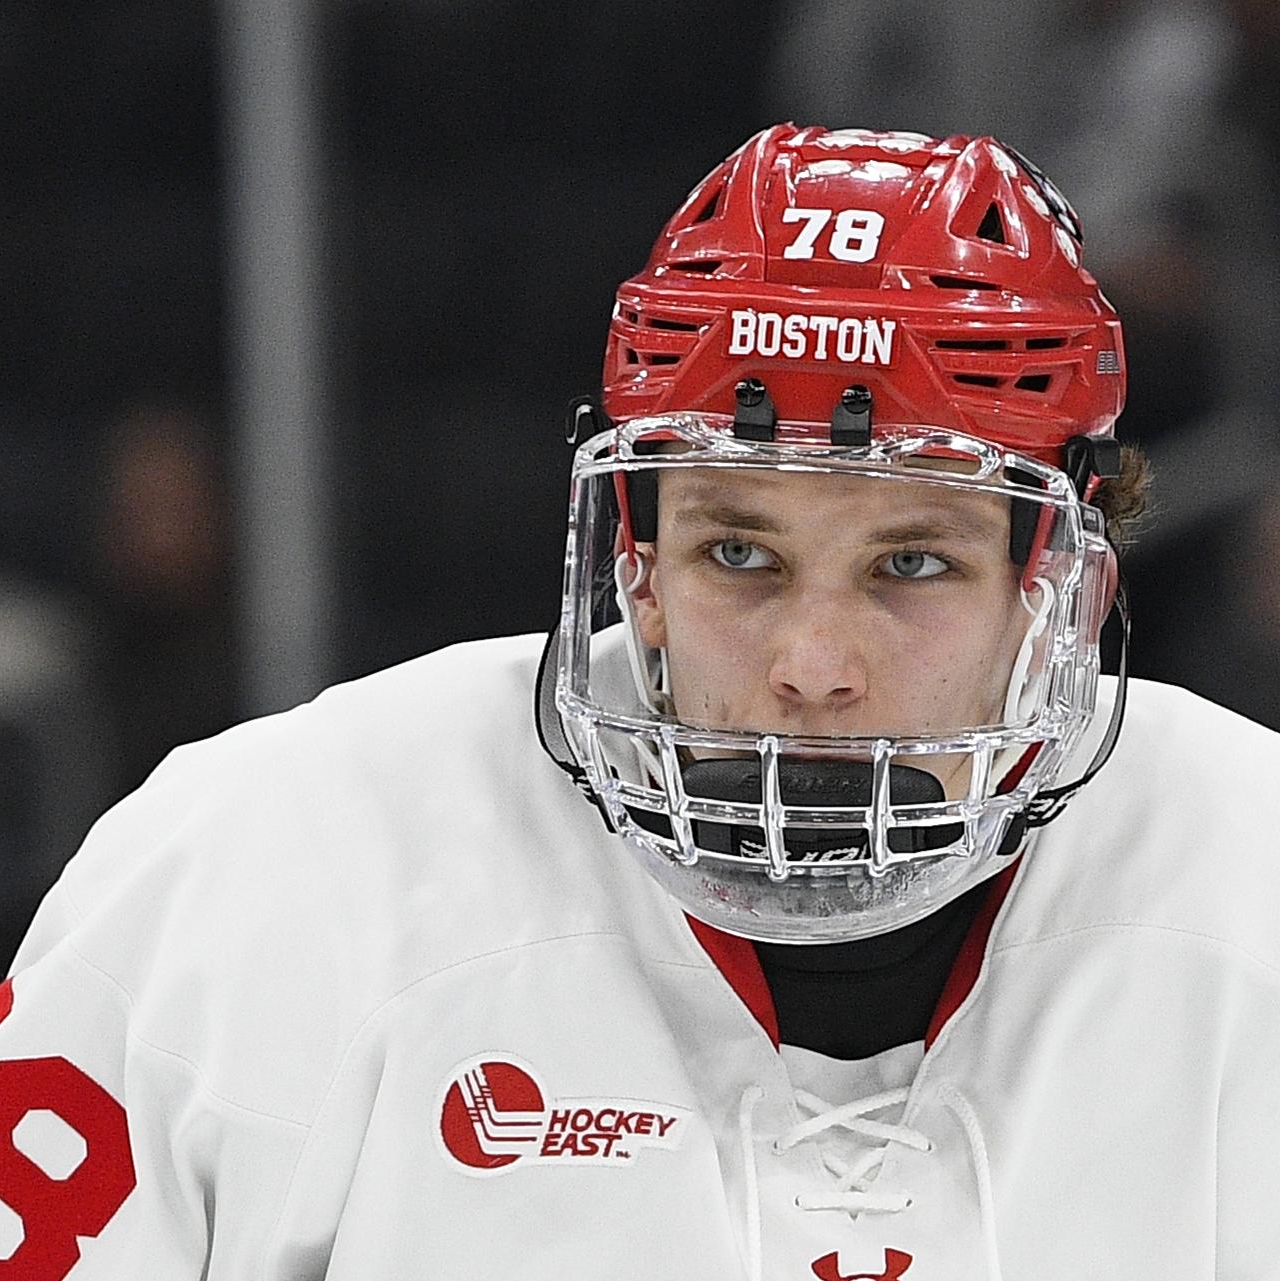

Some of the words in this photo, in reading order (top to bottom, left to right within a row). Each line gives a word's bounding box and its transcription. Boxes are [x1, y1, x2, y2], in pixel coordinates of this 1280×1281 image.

[781, 207, 885, 264] 78
[728, 307, 897, 367] BOSTON
[547, 1108, 677, 1137] HOCKEY
[539, 1132, 623, 1158] EAST
